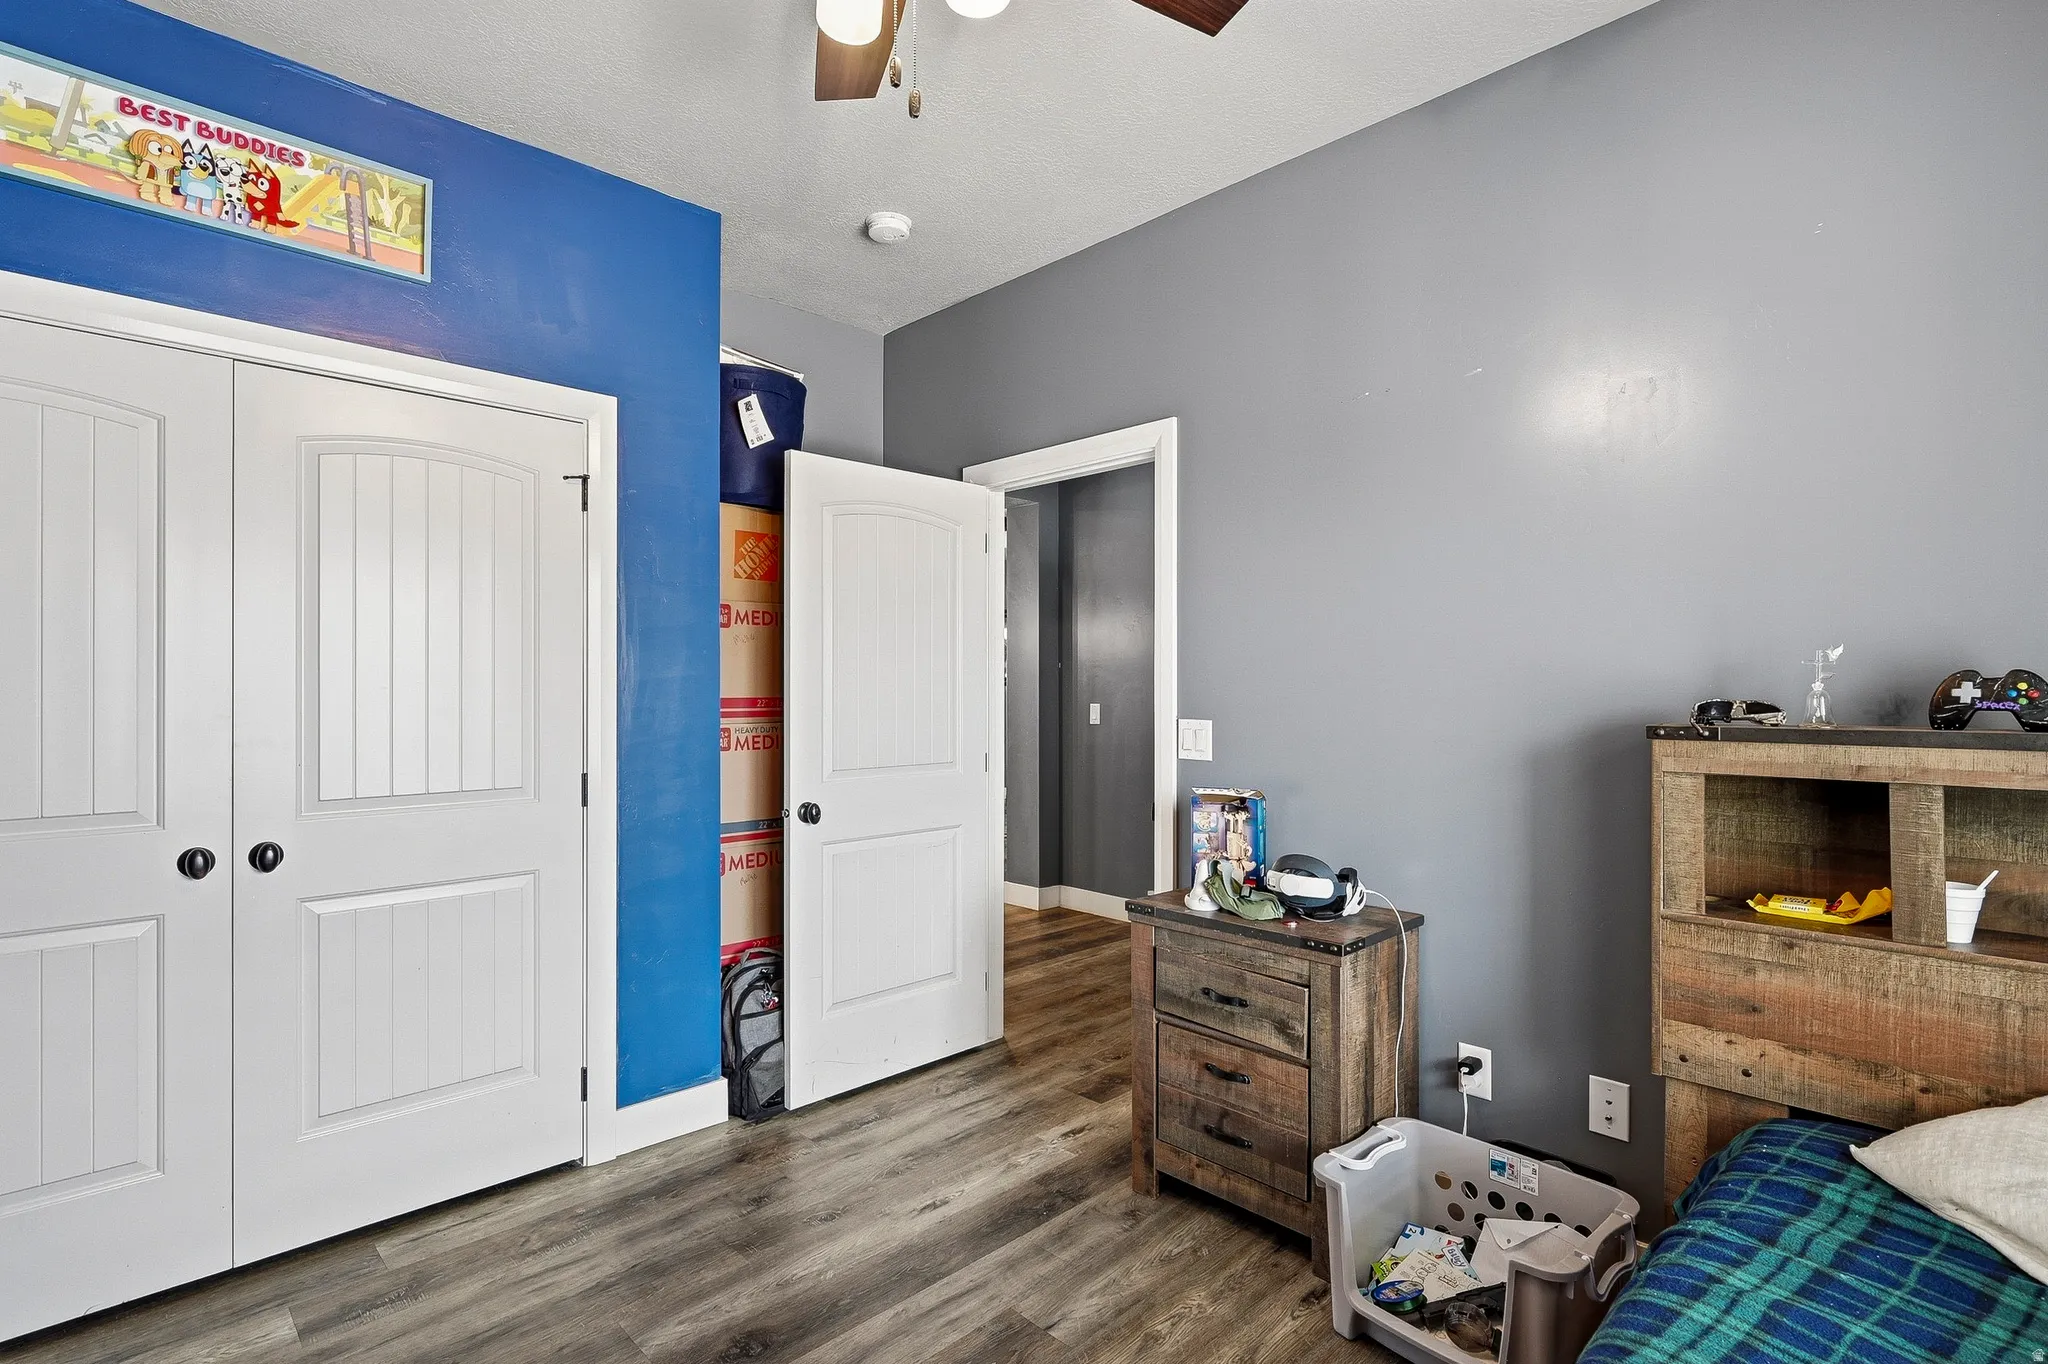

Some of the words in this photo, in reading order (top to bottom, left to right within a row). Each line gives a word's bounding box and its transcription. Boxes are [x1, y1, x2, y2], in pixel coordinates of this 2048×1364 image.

[118, 96, 191, 132] BEST
[196, 120, 305, 168] BUDDIES
[739, 536, 757, 556] THE
[734, 535, 779, 579] HOME
[734, 609, 779, 626] MEDI
[734, 735, 780, 751] MEDI
[729, 850, 784, 871] MEDIU
